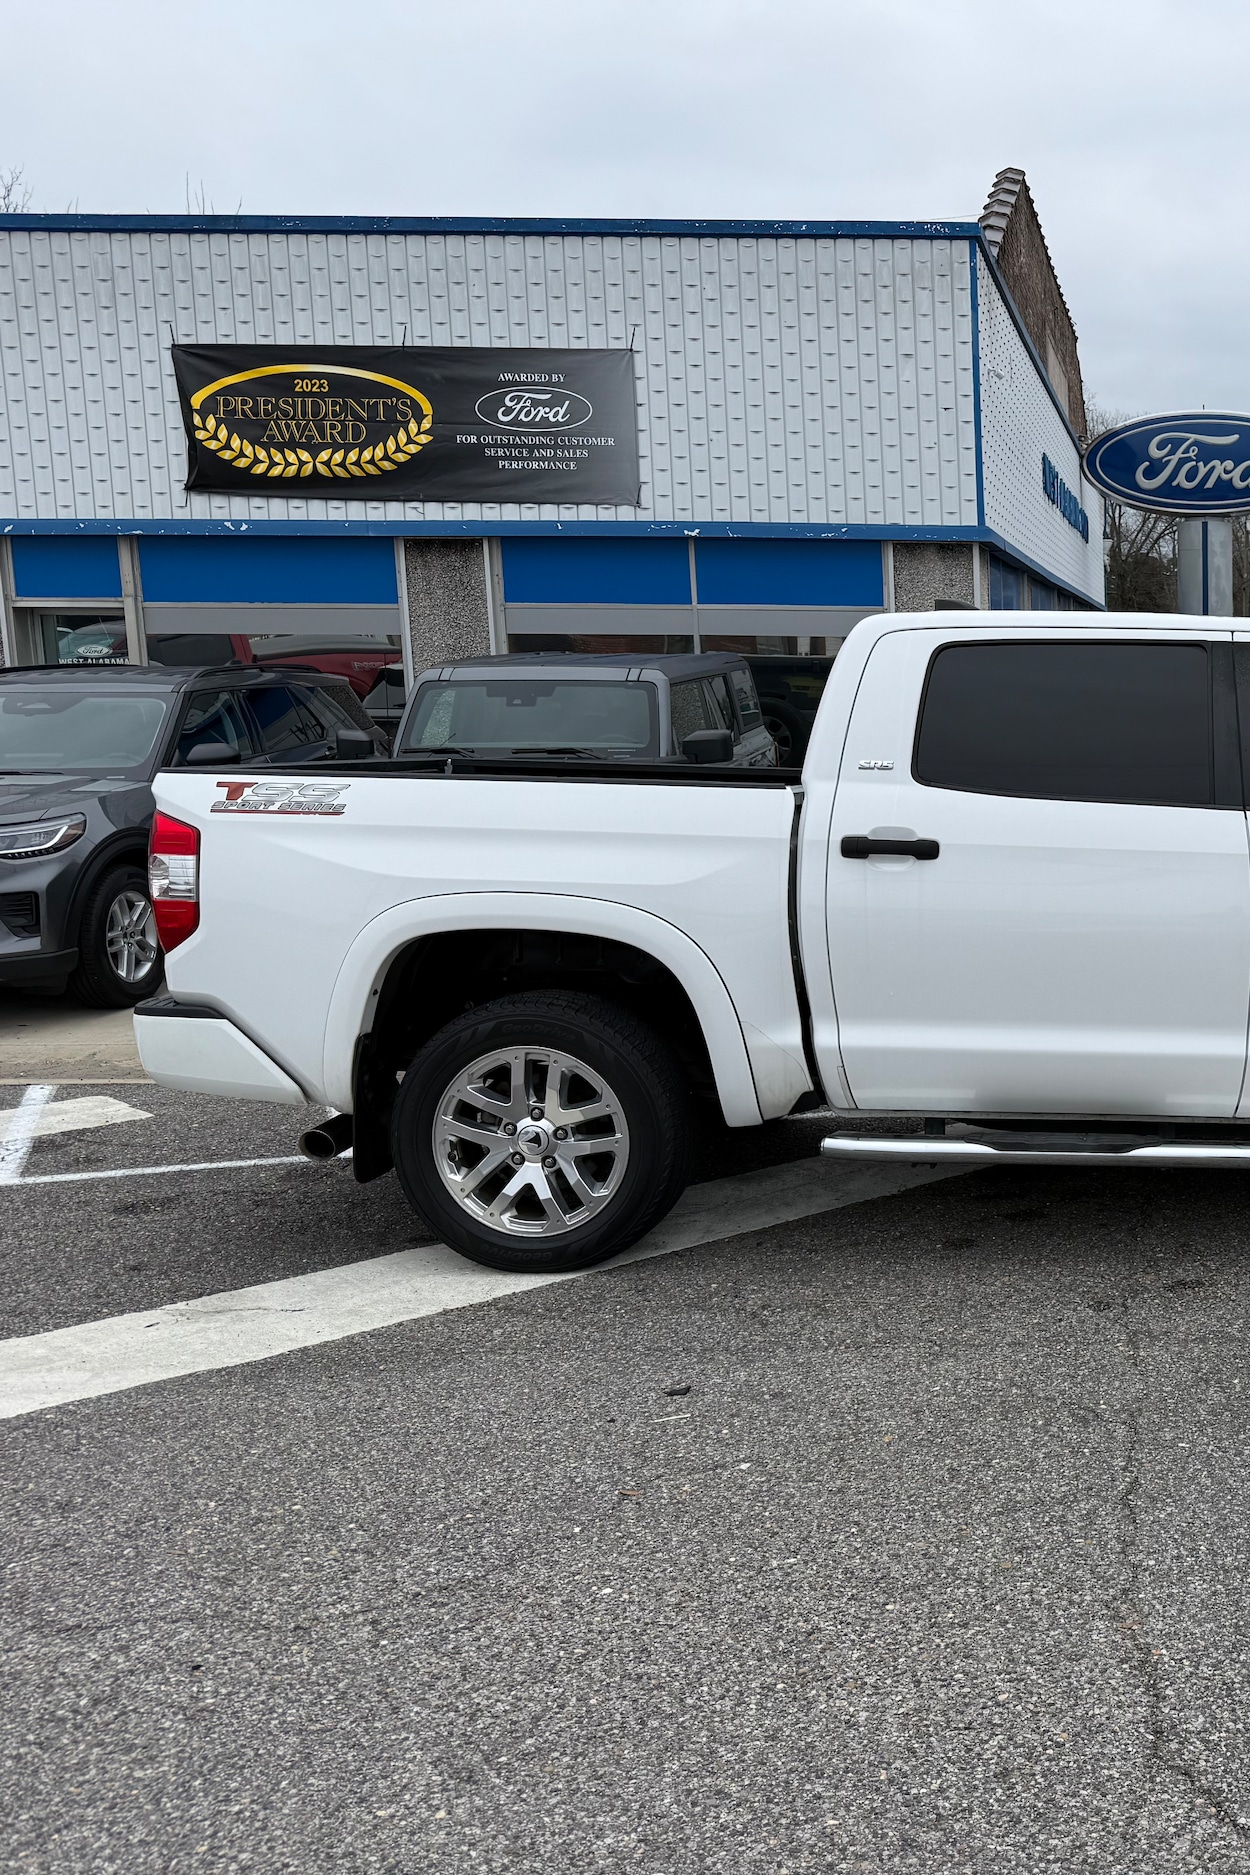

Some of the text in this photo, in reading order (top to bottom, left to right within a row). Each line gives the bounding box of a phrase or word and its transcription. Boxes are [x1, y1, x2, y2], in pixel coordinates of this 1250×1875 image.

[497, 373, 566, 383] AWARDED BY
[294, 379, 329, 393] 2023
[215, 395, 413, 422] PRESIDENT'S
[497, 391, 570, 423] Ford
[260, 420, 367, 445] AWARD
[456, 434, 615, 446] FOR OUTSTANDING CUSTOMER
[484, 447, 589, 458] SERVICE AND SALES
[498, 460, 577, 470] PERFORMANCE
[82, 646, 104, 655] Ford
[215, 781, 351, 803] TSS
[210, 800, 347, 812] SPORT SERIES
